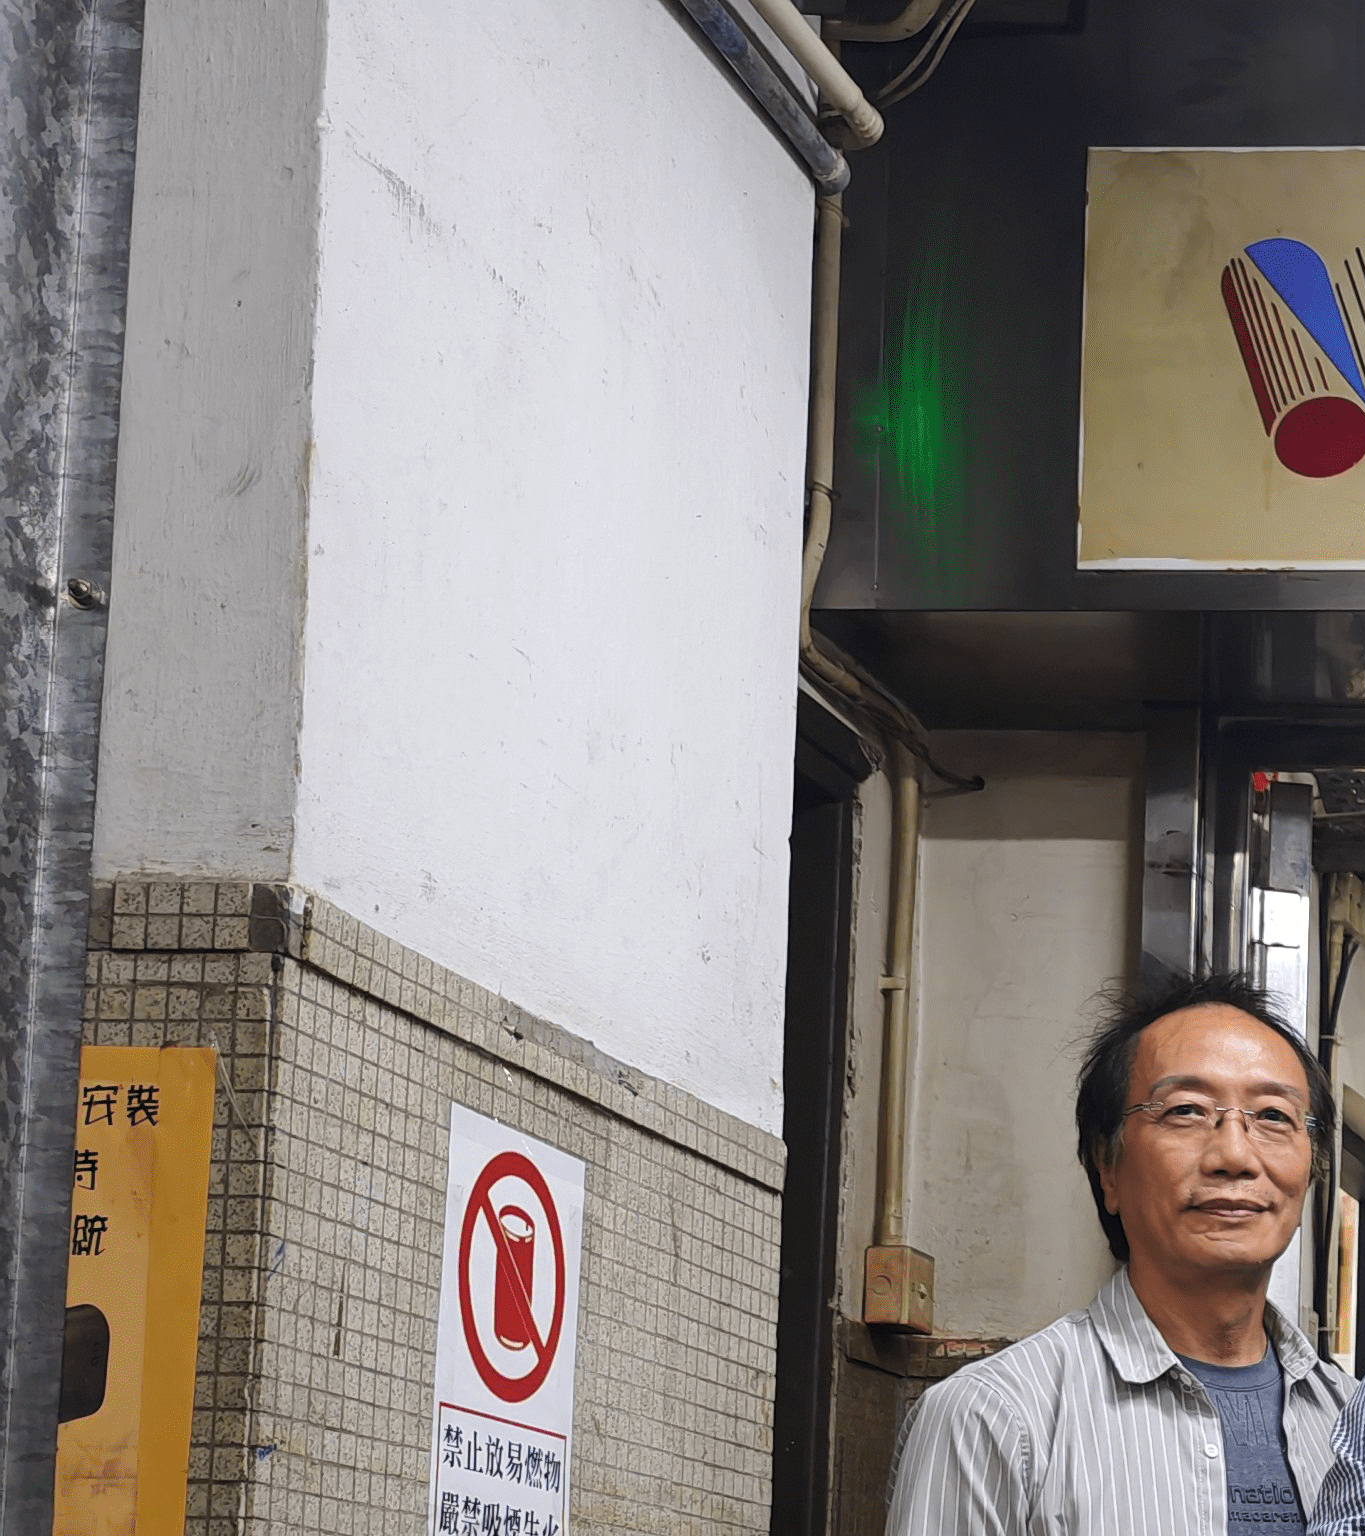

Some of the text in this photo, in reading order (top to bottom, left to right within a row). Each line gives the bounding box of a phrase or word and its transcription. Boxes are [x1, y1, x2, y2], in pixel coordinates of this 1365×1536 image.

[442, 1424, 561, 1493] 禁止放易燃物
